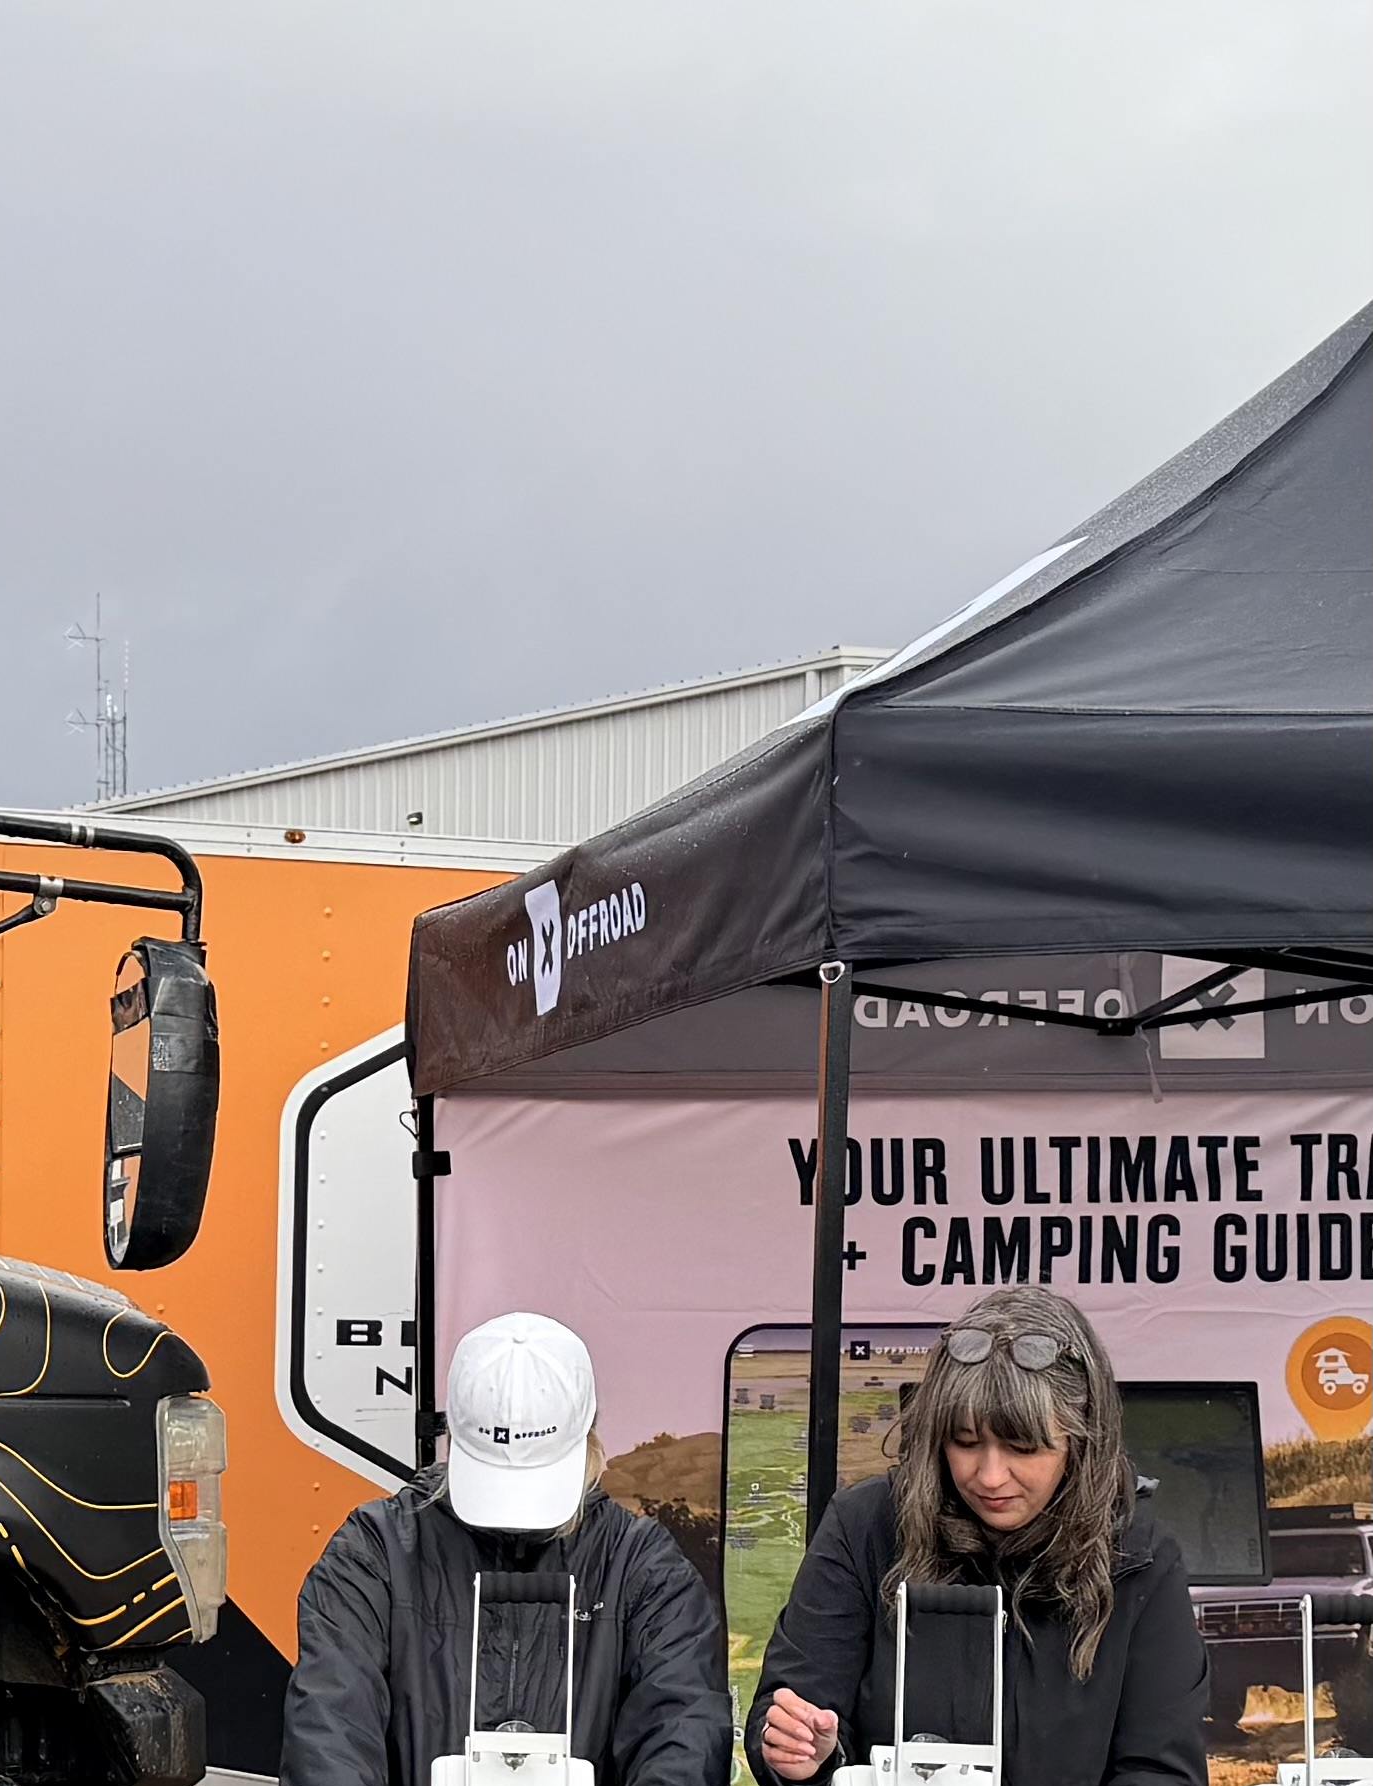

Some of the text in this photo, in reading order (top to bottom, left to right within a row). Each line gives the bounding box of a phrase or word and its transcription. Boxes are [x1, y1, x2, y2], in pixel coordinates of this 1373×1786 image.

[507, 939, 527, 986] ON
[567, 882, 645, 959] OFFROAD
[980, 1135, 1263, 1206] ULTIMATE
[1290, 1134, 1373, 1201] TR
[901, 1213, 1181, 1286] CAMPING
